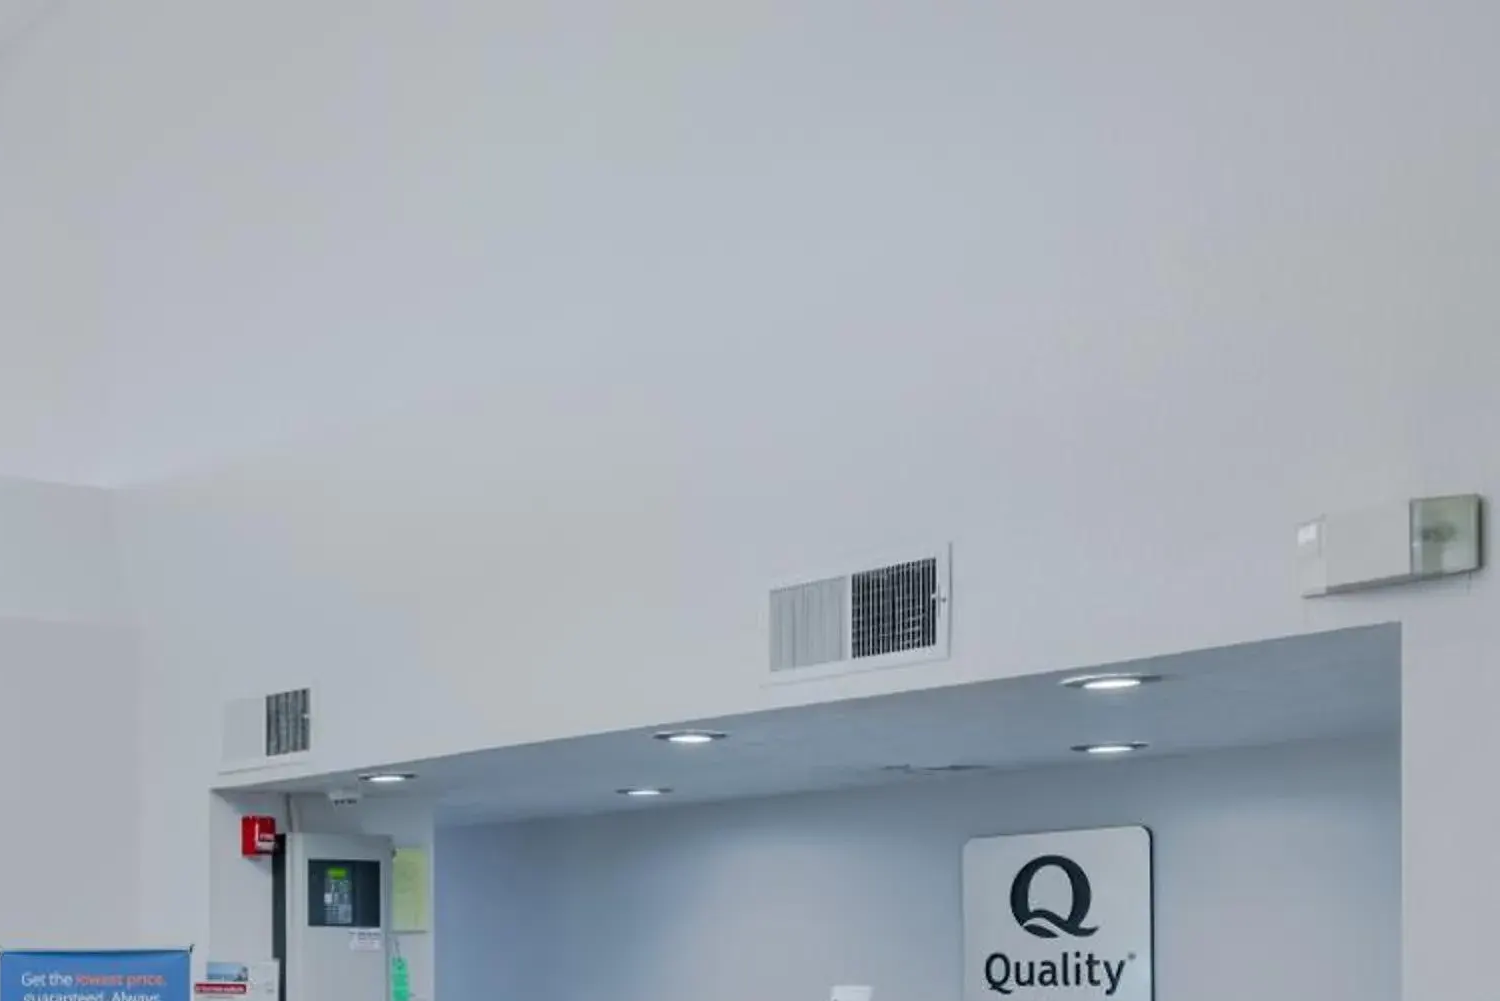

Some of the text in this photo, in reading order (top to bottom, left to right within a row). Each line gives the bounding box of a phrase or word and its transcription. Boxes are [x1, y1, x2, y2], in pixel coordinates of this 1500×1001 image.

[1010, 855, 1100, 939] Q
[21, 972, 46, 987] Get
[49, 971, 73, 986] the
[985, 951, 1126, 995] Quality
